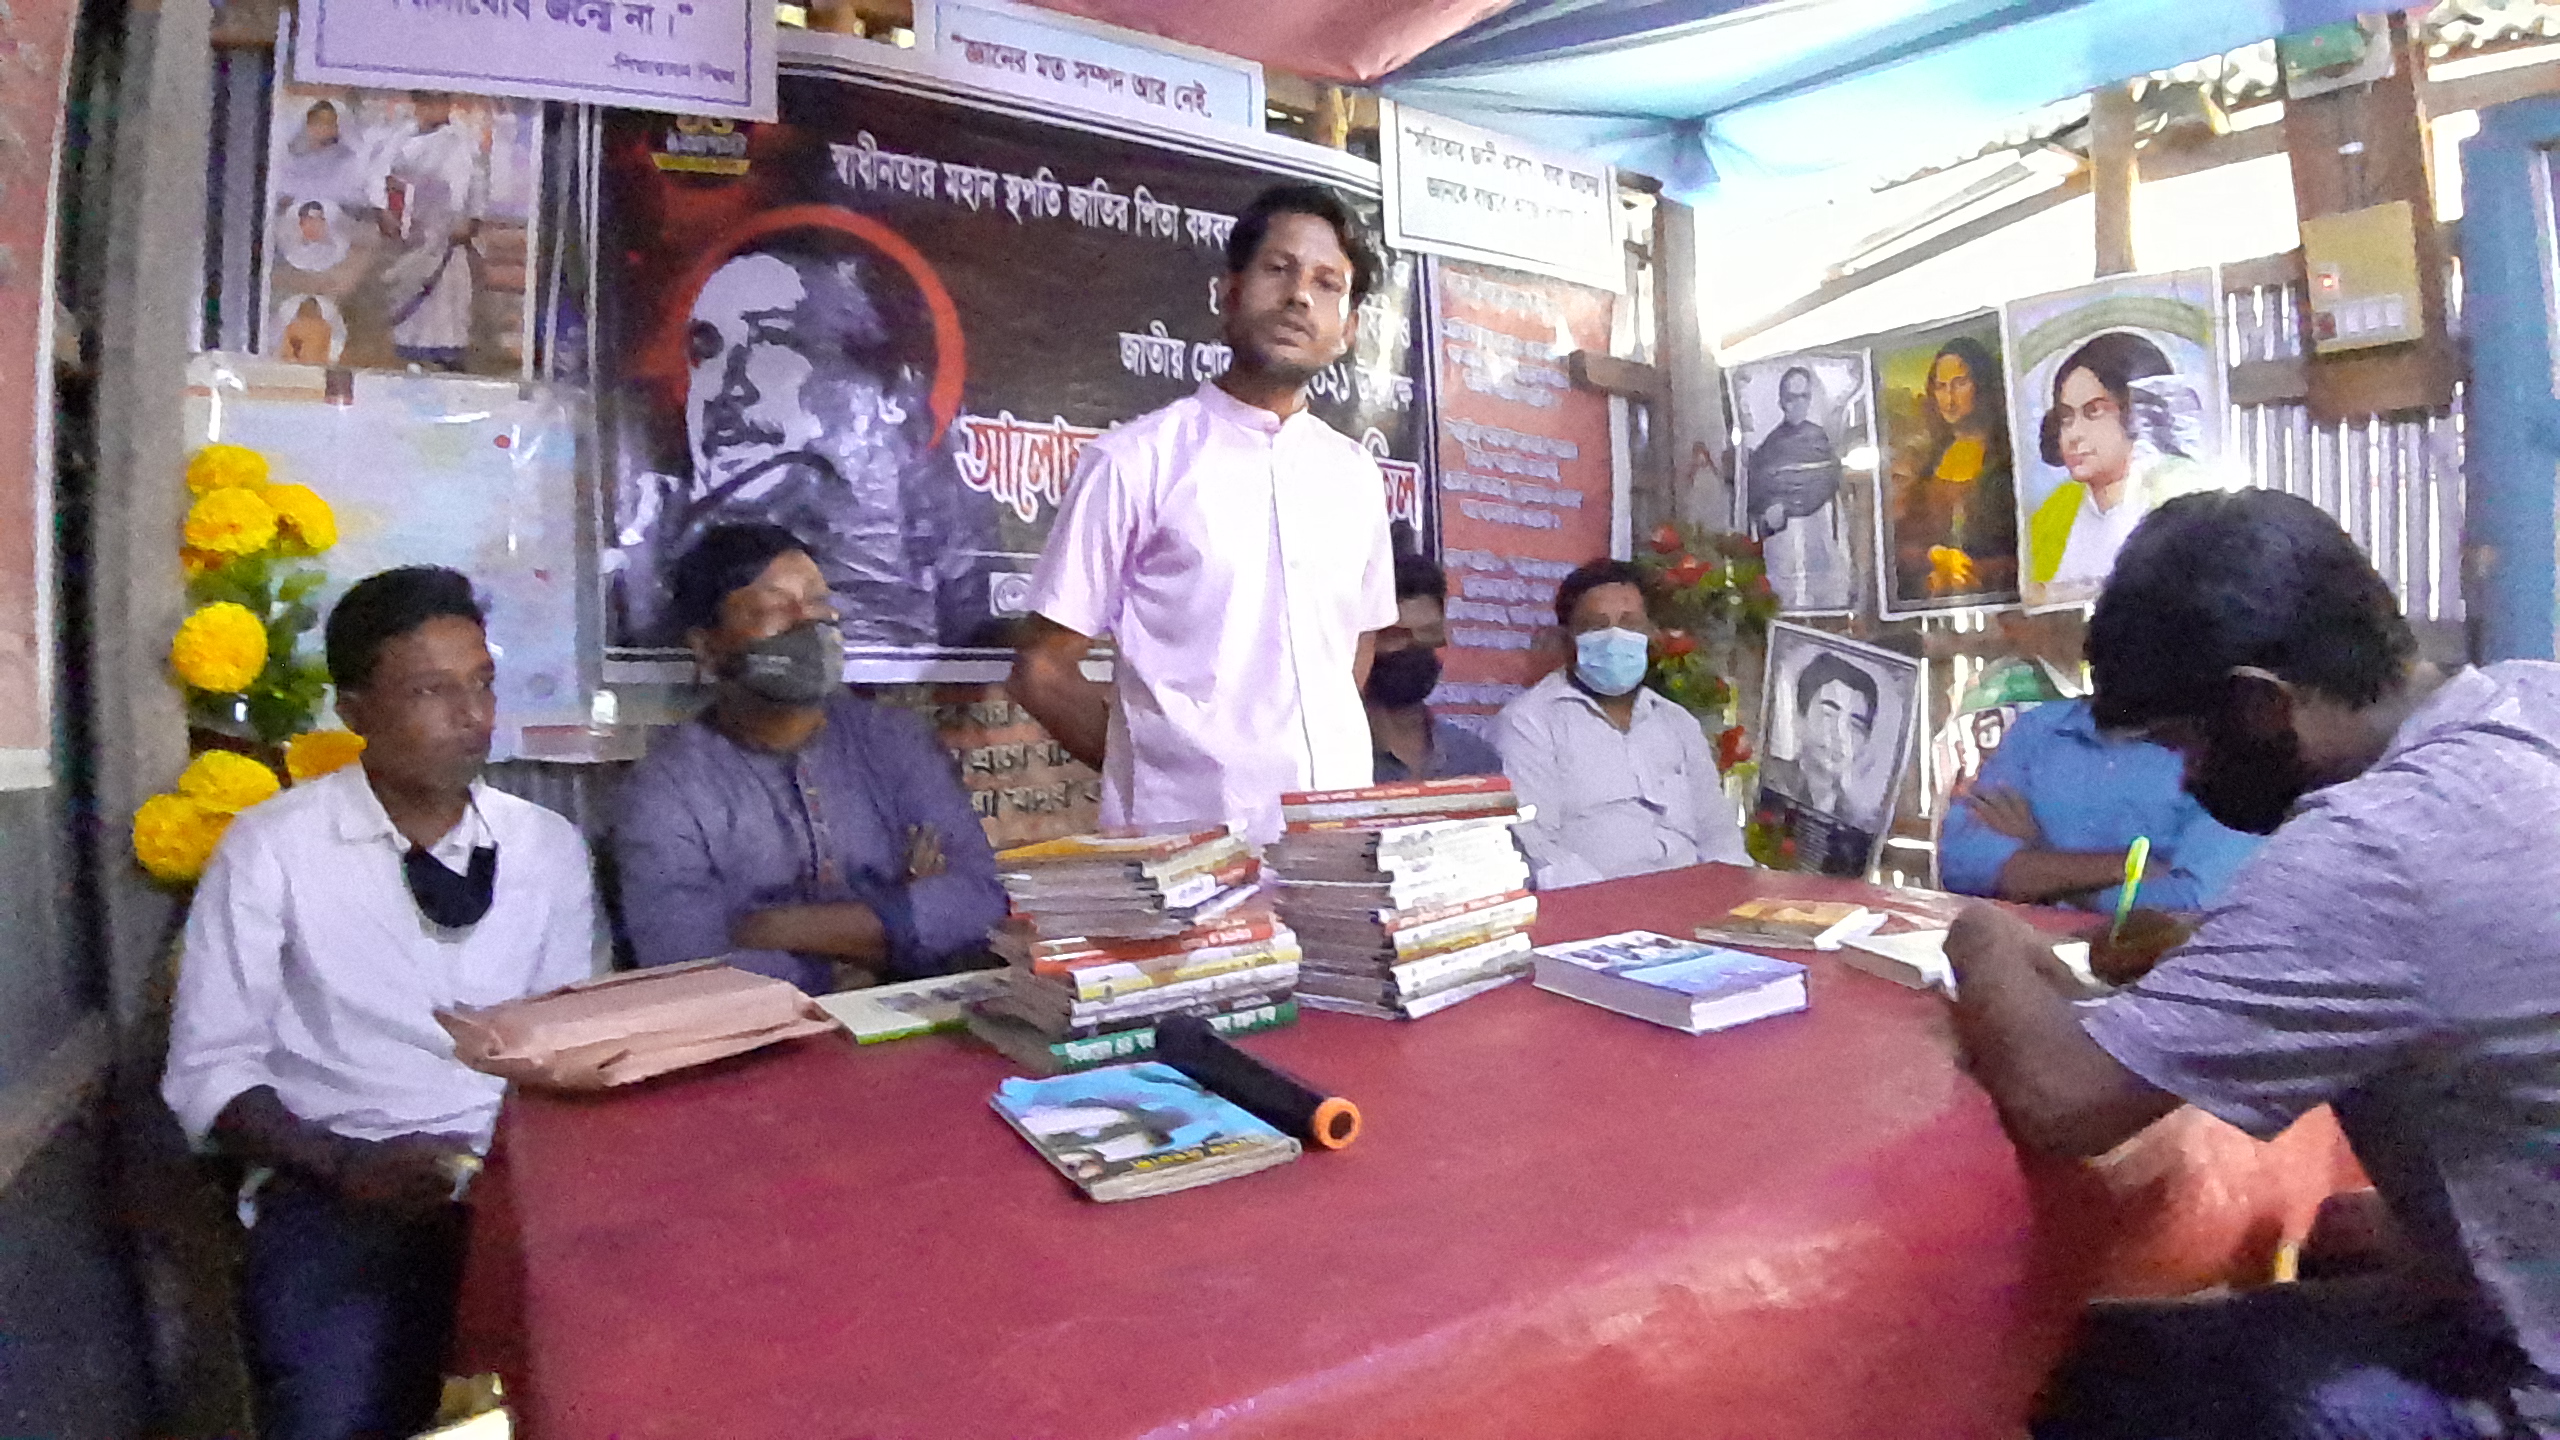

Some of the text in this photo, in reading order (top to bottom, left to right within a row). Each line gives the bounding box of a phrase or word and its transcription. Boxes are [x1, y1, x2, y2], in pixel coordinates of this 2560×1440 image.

[1034, 53, 1066, 81] মত
[1132, 74, 1166, 106] আর
[829, 130, 938, 200] স্বাধীনতার
[942, 161, 998, 212] মহান
[1002, 166, 1064, 225] স্থপতি
[1067, 177, 1131, 232] জাতির
[1133, 185, 1181, 243] পিতা
[1119, 319, 1187, 380] জাতীয়
